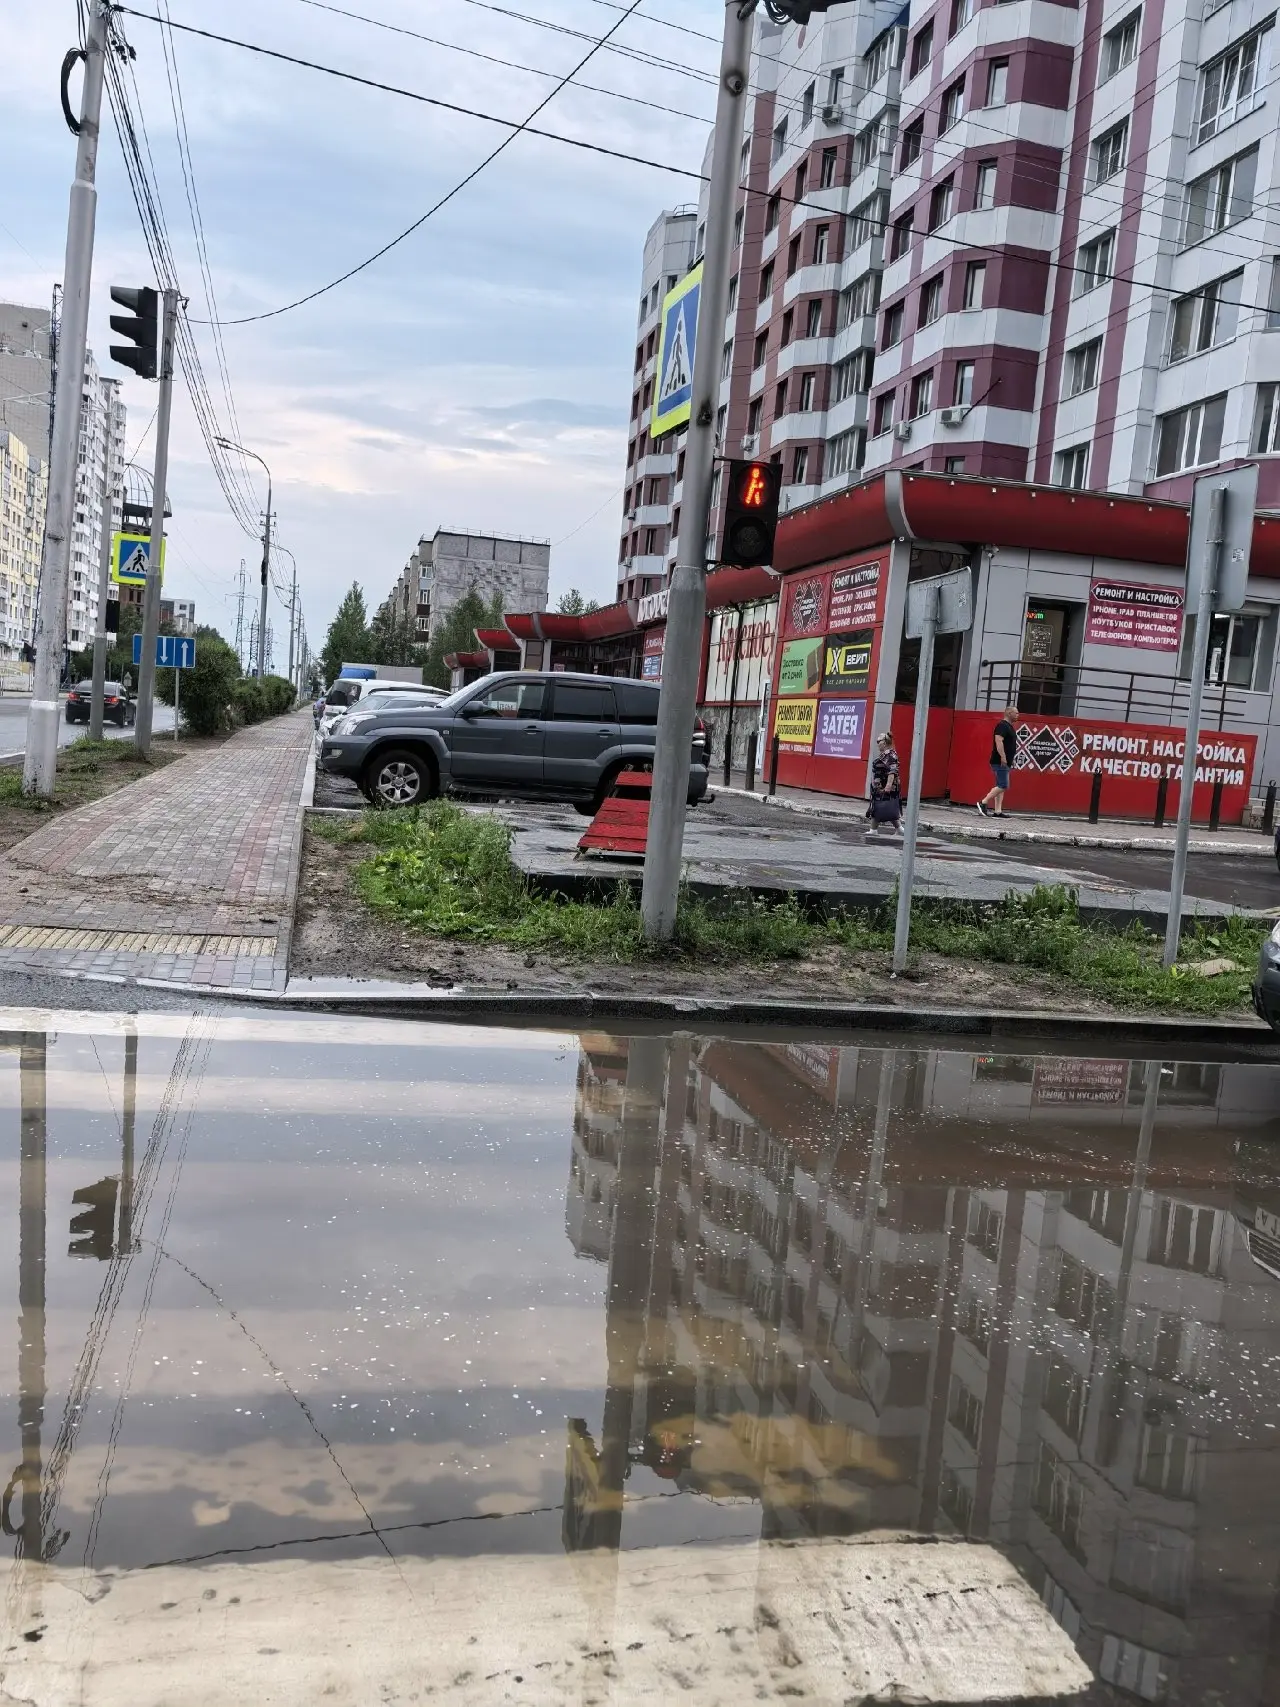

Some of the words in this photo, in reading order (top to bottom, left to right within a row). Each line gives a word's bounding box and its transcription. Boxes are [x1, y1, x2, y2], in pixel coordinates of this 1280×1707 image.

[1095, 587, 1126, 599] РЕМОНТ
[1127, 591, 1134, 600] И
[1135, 592, 1179, 605] НАСТРОЙКА
[1136, 610, 1178, 621] ПЛАНШЕТОВ
[1091, 618, 1133, 629] НОУТБУКОВ
[1135, 622, 1177, 634] ПРИСТАВОК
[1091, 630, 1132, 641] ТЕЛЕФОНОВ
[1133, 634, 1178, 646] КОМПЬЮТЕРОВ
[822, 715, 859, 736] ЗАТЕЯ
[1152, 739, 1246, 764] НАСРОЙКА
[1166, 763, 1244, 785] ГААНТИЯ
